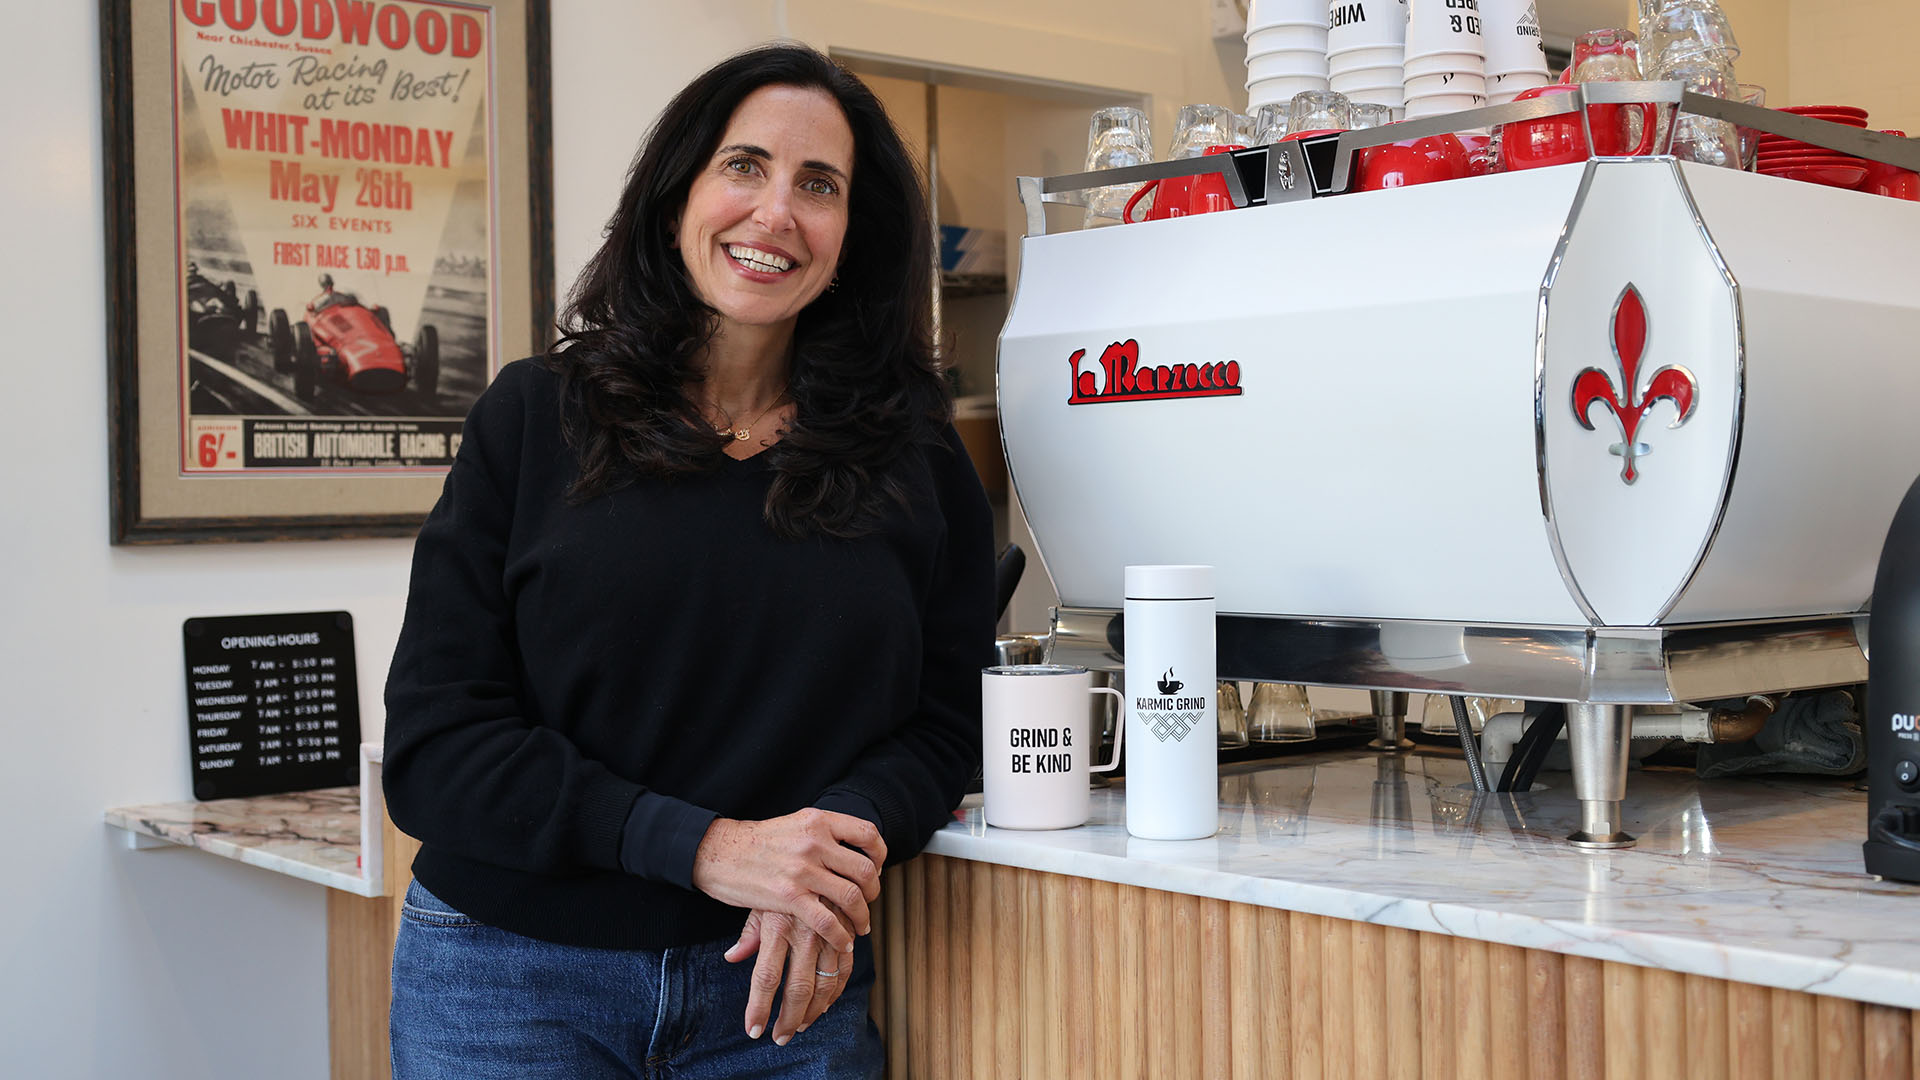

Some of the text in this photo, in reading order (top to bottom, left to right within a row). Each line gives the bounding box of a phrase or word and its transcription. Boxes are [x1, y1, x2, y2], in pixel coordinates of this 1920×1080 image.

[181, 0, 482, 58] GOODWOOD
[199, 54, 388, 97] Motor Racing
[303, 69, 470, 111] at its Best!
[220, 107, 455, 169] WHIT-MONDAY
[268, 160, 413, 214] May 26th
[290, 212, 393, 235] SIX EVENTS
[272, 241, 311, 268] FIRST
[315, 243, 350, 270] RACE
[253, 432, 308, 459] BRITISH
[312, 432, 395, 459] AUTOMOBILE
[399, 433, 446, 459] RACING
[220, 632, 321, 650] OPENING HOURS
[192, 664, 231, 675] MONDAY
[259, 661, 276, 670] AM
[320, 657, 336, 667] PM
[194, 679, 234, 691] TUESDAY
[263, 678, 279, 688] AM
[321, 673, 336, 683] PM
[194, 694, 248, 707] WEDNESDAY
[265, 694, 281, 704] AM
[320, 688, 336, 698] PM
[1136, 696, 1206, 711] KARMIC GRIND
[196, 710, 242, 722] THURSDAY
[264, 709, 281, 718] AM
[322, 703, 337, 712] PM
[196, 727, 229, 739] FRIDAY
[265, 725, 281, 735] AM
[323, 720, 339, 730] PM
[1010, 727, 1073, 748] GRIND &
[198, 742, 243, 754] SATURDAY
[266, 740, 282, 750] AM
[324, 735, 340, 746] PM
[199, 758, 235, 770] SUNDAY
[265, 755, 282, 766] AM
[325, 750, 341, 761] PM
[1012, 753, 1072, 774] BE KIND
